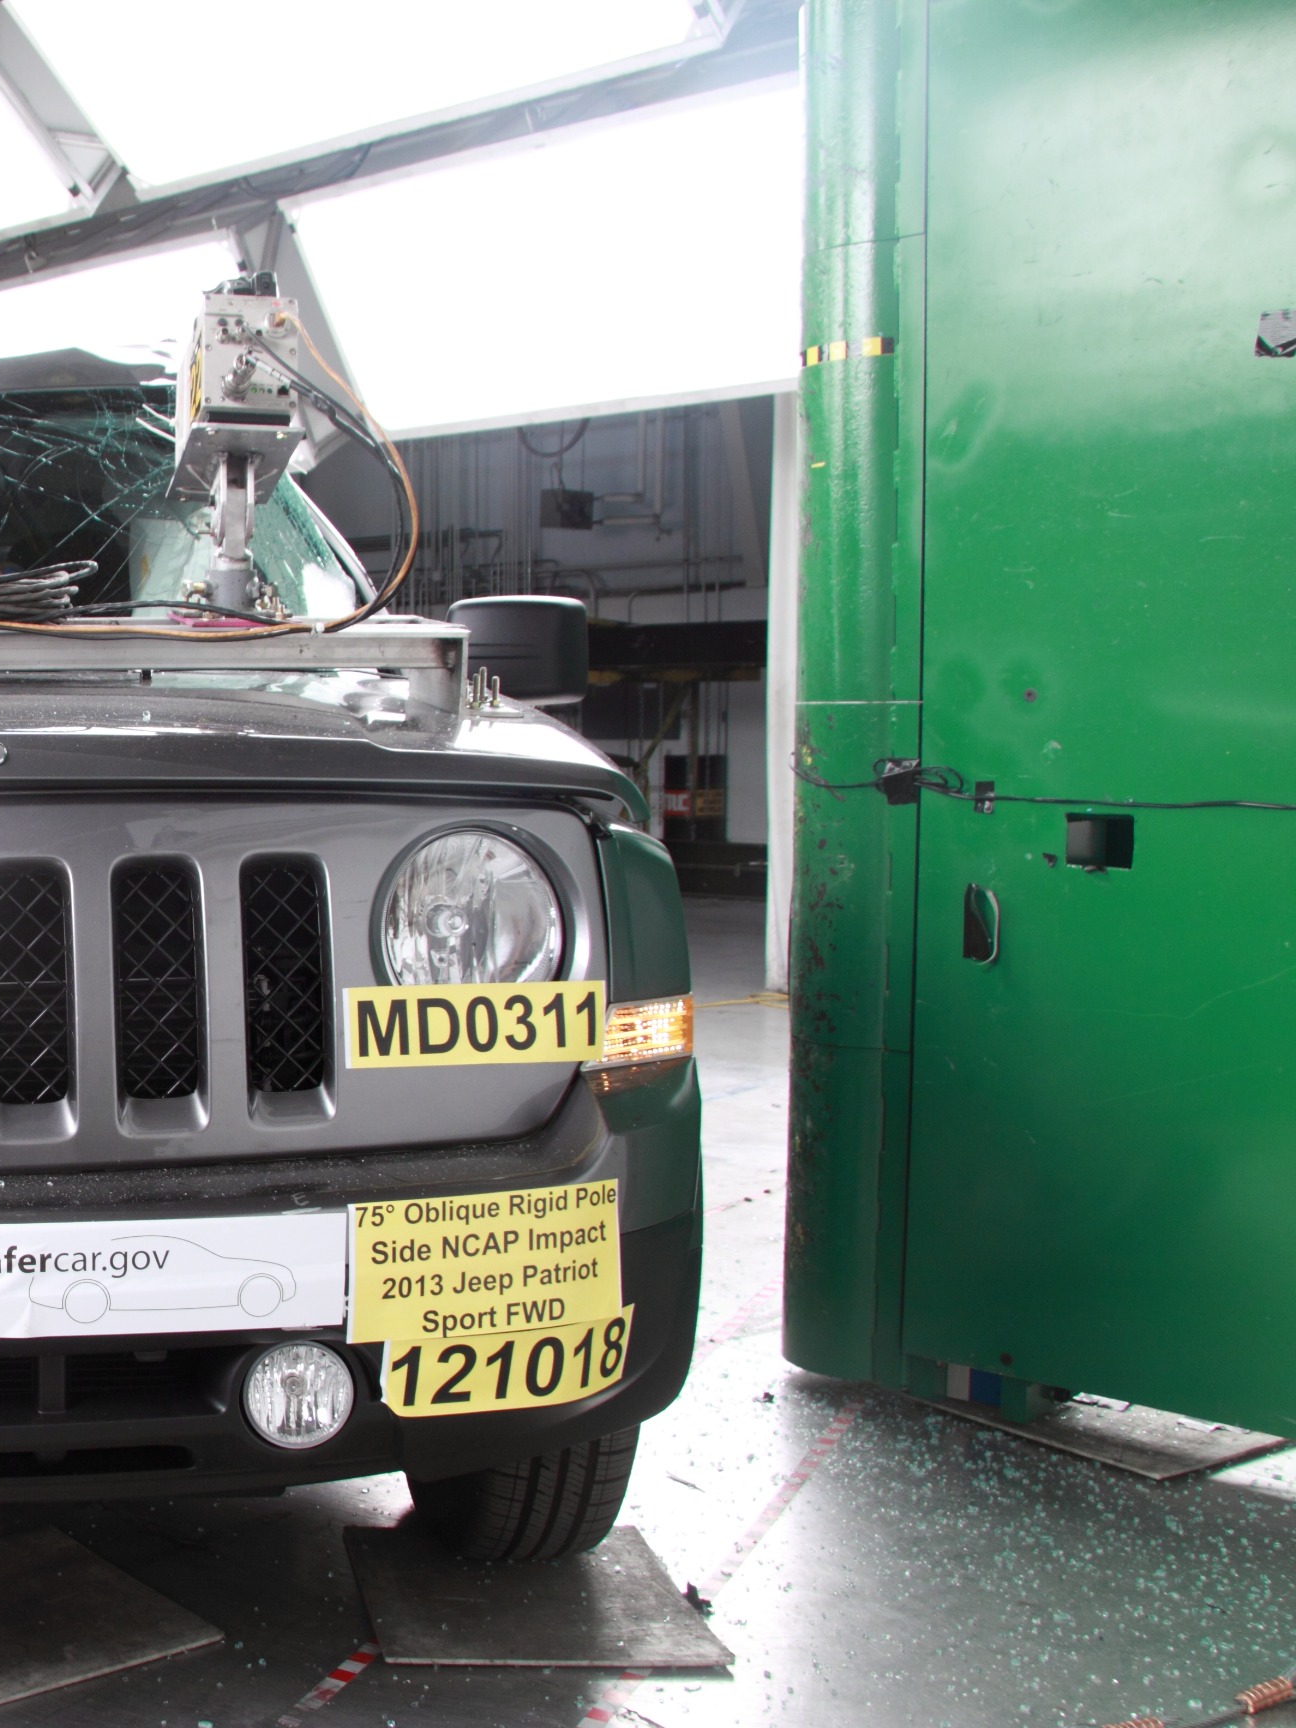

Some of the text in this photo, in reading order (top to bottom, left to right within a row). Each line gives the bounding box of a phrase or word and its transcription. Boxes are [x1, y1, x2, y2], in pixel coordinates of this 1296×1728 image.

[357, 991, 596, 1058] MD0311
[355, 1184, 616, 1228] 75° Oblique Rigid Pole
[371, 1220, 606, 1265] Side NCAP Impact
[382, 1257, 598, 1300] 2013 Jeep Patriot
[422, 1298, 565, 1338] Sport FWD
[391, 1316, 626, 1407] 121018
